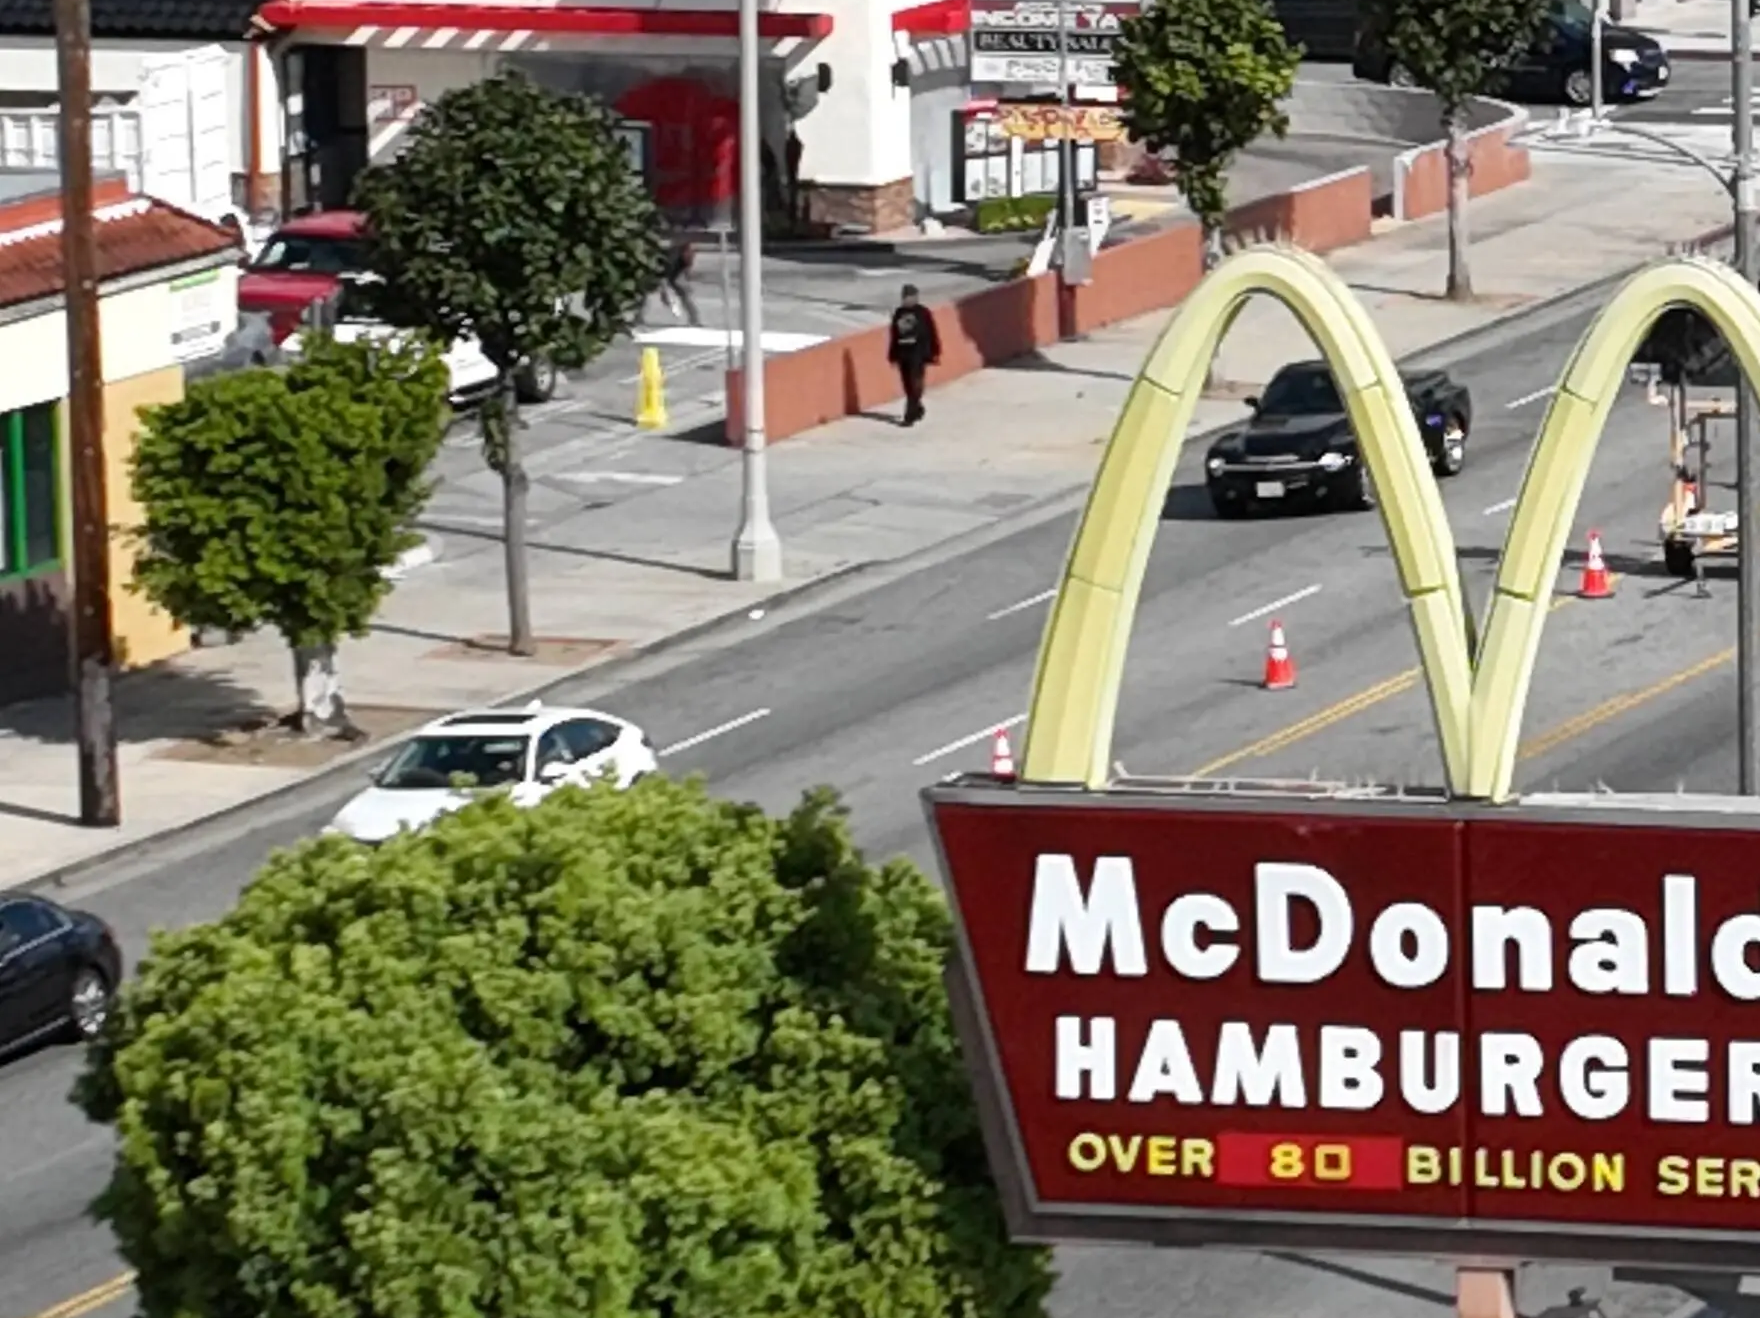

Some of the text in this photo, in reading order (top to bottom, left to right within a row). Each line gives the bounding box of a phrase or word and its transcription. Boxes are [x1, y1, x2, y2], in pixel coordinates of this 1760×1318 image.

[979, 33, 1059, 50] BEAUTY
[1068, 1132, 1214, 1177] OVER
[1269, 1143, 1351, 1180] 80
[1407, 1146, 1625, 1193] BILLION
